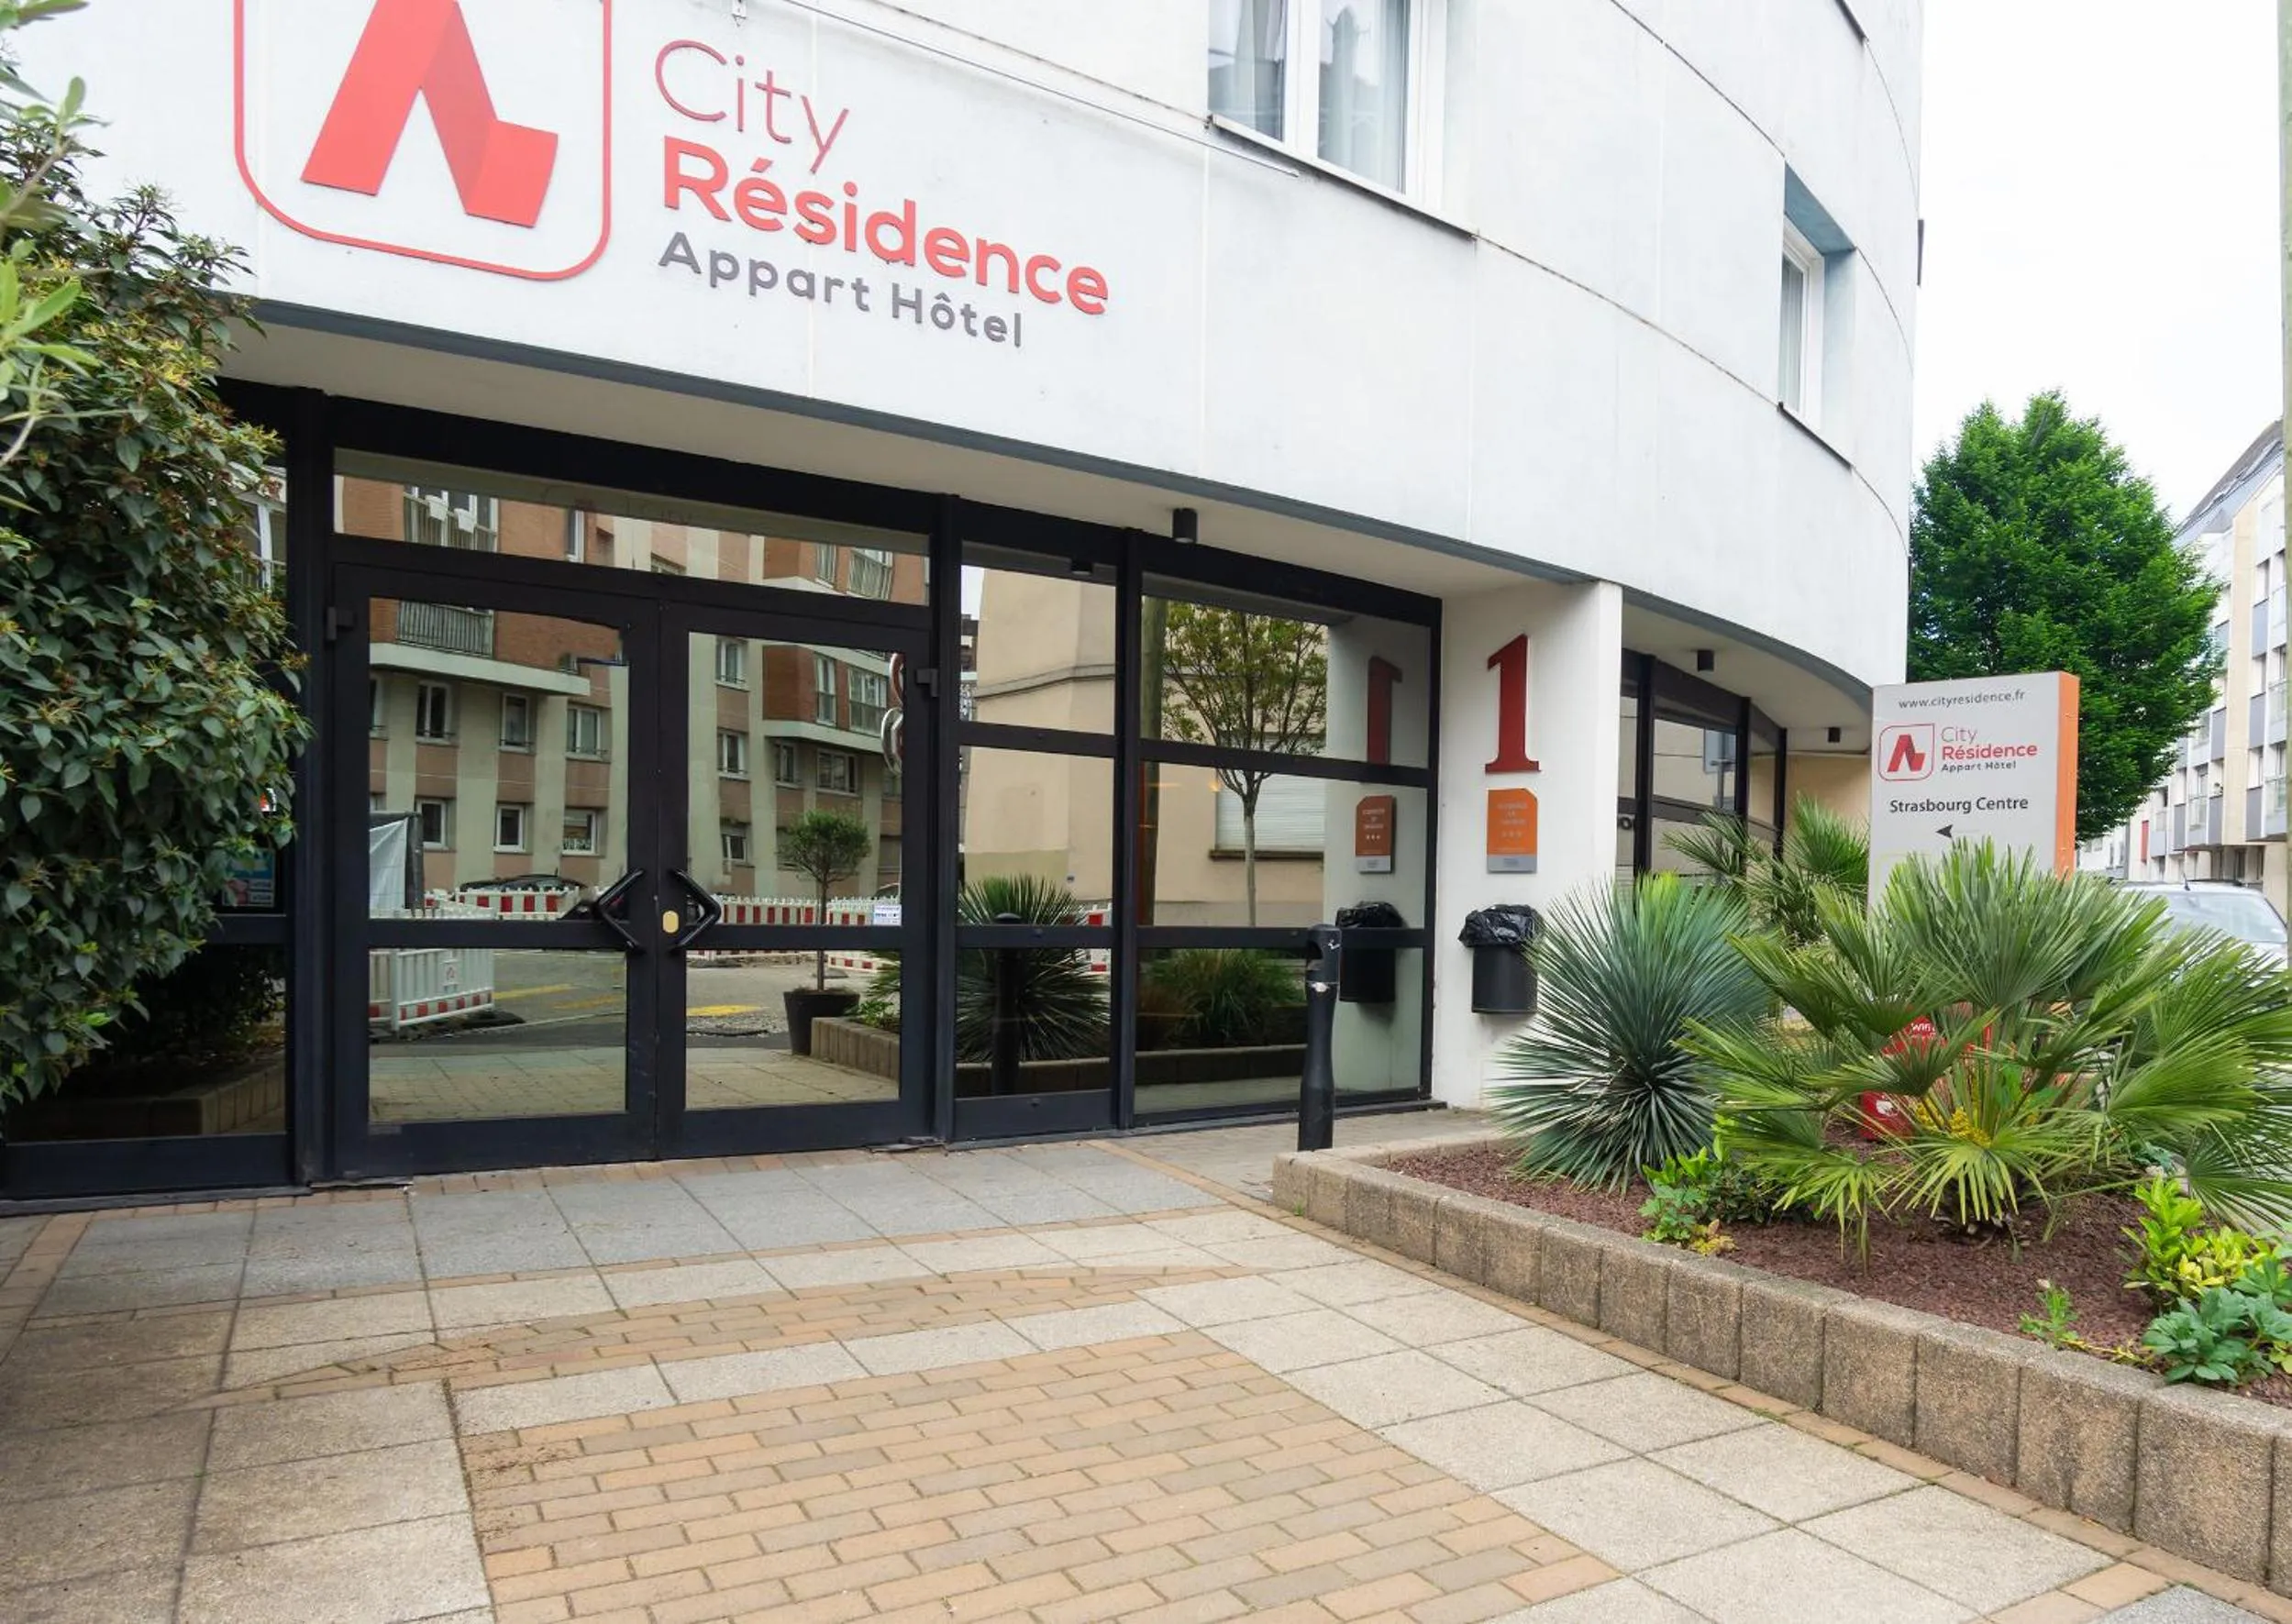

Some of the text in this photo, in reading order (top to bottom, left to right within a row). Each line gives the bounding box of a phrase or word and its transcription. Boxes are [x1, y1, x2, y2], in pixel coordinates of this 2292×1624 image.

[655, 39, 849, 174] City
[664, 135, 1108, 315] Résidence
[658, 231, 1022, 348] Appart Hôtel
[1485, 633, 1542, 775] 1
[1899, 690, 2026, 709] www.cityresidence.fr
[1941, 725, 1978, 745] City
[1942, 742, 2038, 760] Résidence
[1941, 760, 2017, 773] Appart Hôtel
[1890, 796, 2029, 814] Strasbourg Centre
